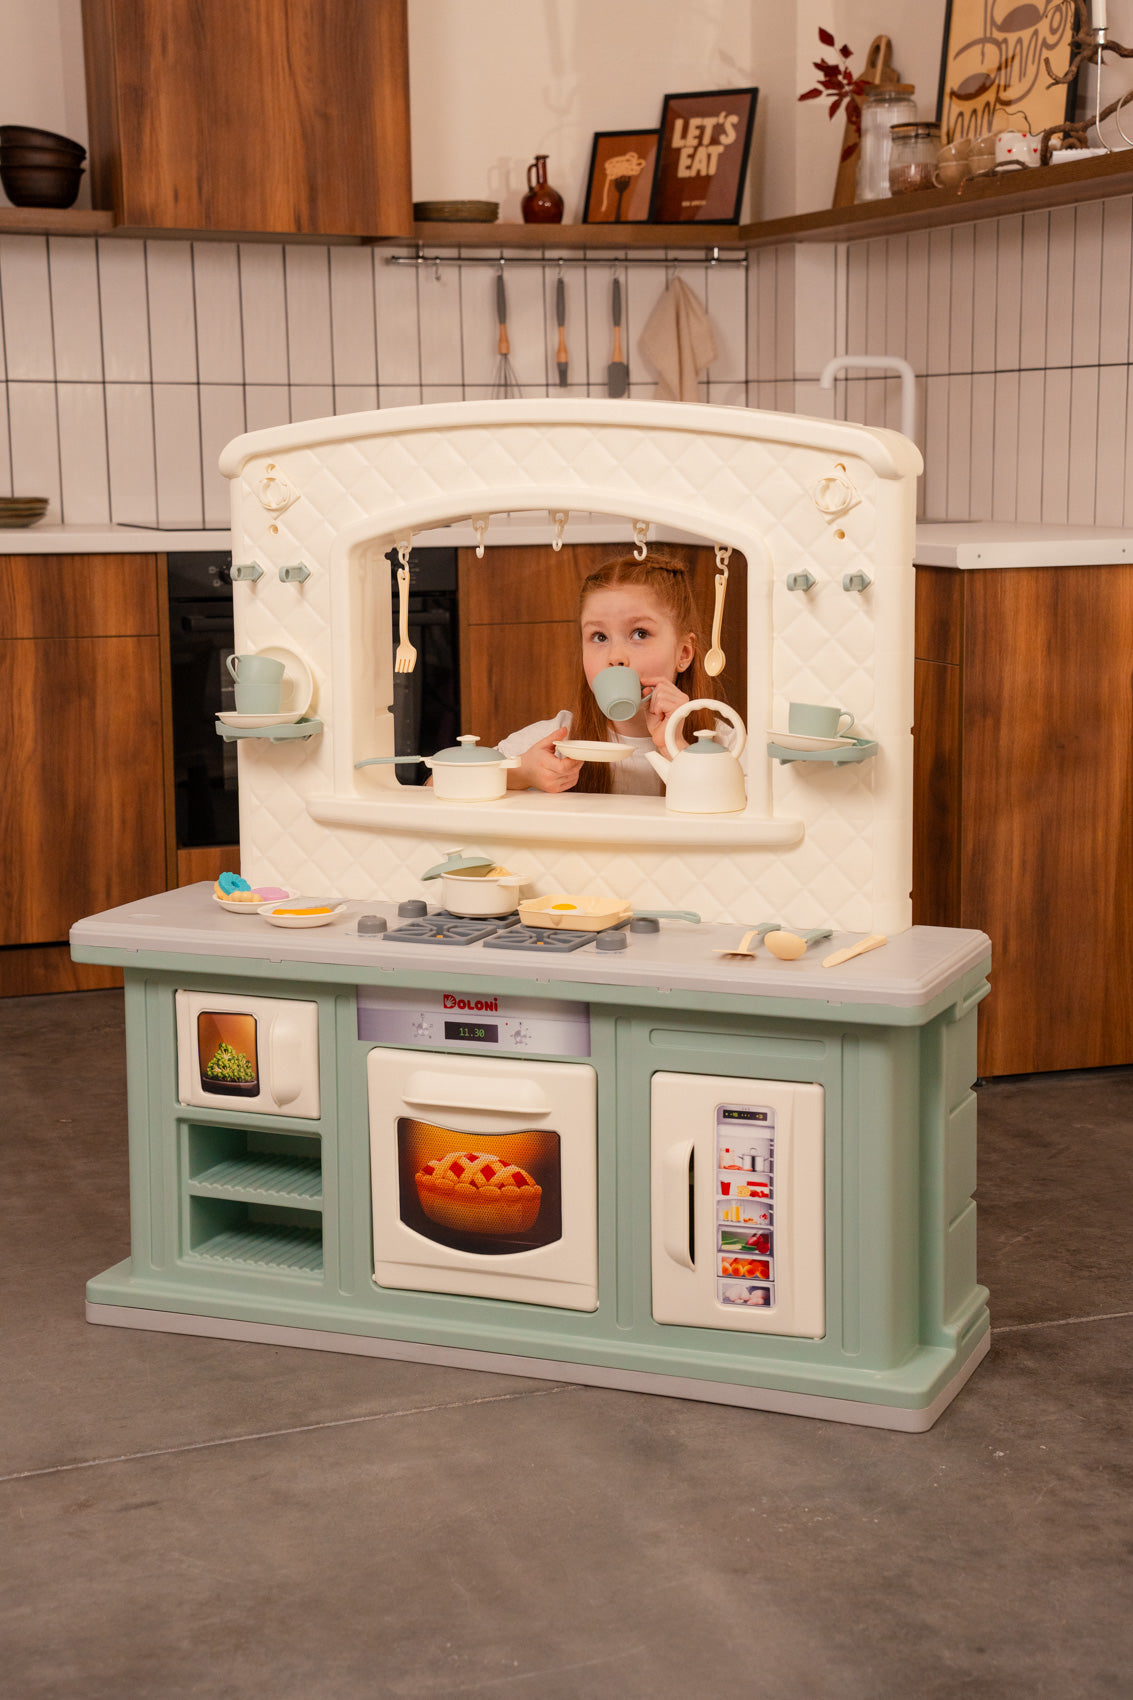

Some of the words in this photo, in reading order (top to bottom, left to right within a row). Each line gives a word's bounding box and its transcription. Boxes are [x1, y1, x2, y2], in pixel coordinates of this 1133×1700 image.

[671, 112, 739, 148] LET'S
[677, 145, 724, 178] EAT
[459, 1027, 485, 1038] 11.30
